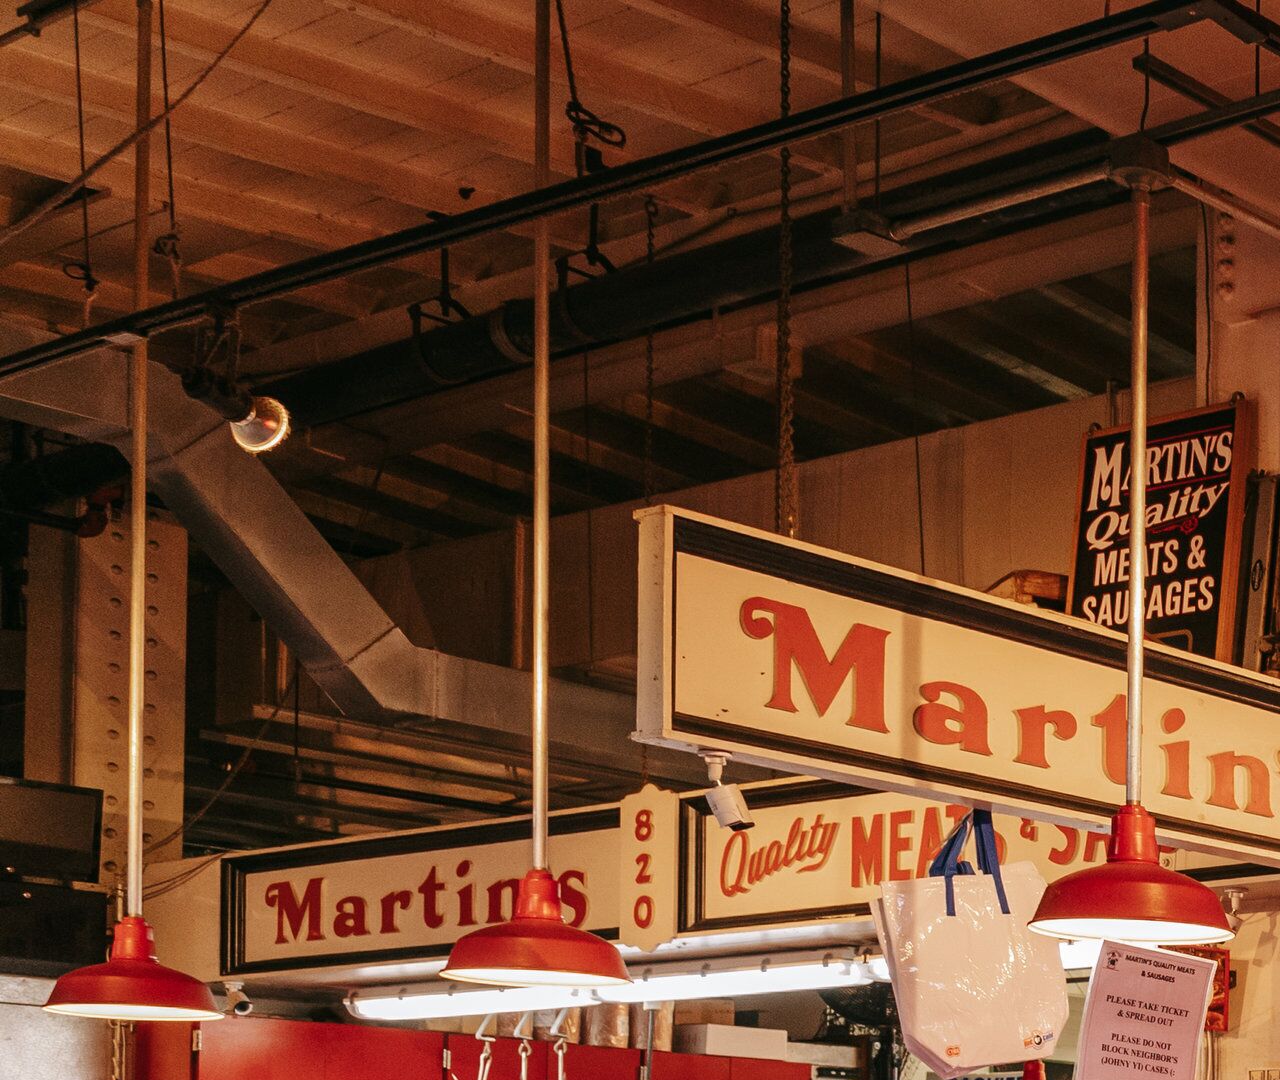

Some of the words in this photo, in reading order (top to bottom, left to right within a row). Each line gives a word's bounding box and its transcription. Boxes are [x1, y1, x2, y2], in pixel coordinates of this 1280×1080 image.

[1087, 431, 1233, 512] MRTIN'S
[1086, 482, 1230, 550] Quality
[1094, 539, 1179, 587] METS
[1187, 534, 1206, 570] &
[1082, 575, 1215, 627] SAUAGES
[633, 808, 655, 930] 820
[719, 814, 840, 897] Quality
[265, 860, 588, 944] Martins
[1106, 994, 1137, 1009] PLEASE
[1138, 1000, 1160, 1012] TAKE
[1160, 1004, 1190, 1018] TICKET
[1117, 1009, 1124, 1018] &
[1125, 1010, 1156, 1024] SPREAD
[1157, 1015, 1175, 1027] OUT
[1101, 1043, 1130, 1056] BLOCK
[1131, 1049, 1179, 1064] NEIGHBOR'S
[1111, 1033, 1141, 1046] PLEASE
[1142, 1037, 1155, 1048] DO
[1156, 1040, 1172, 1051] NOT
